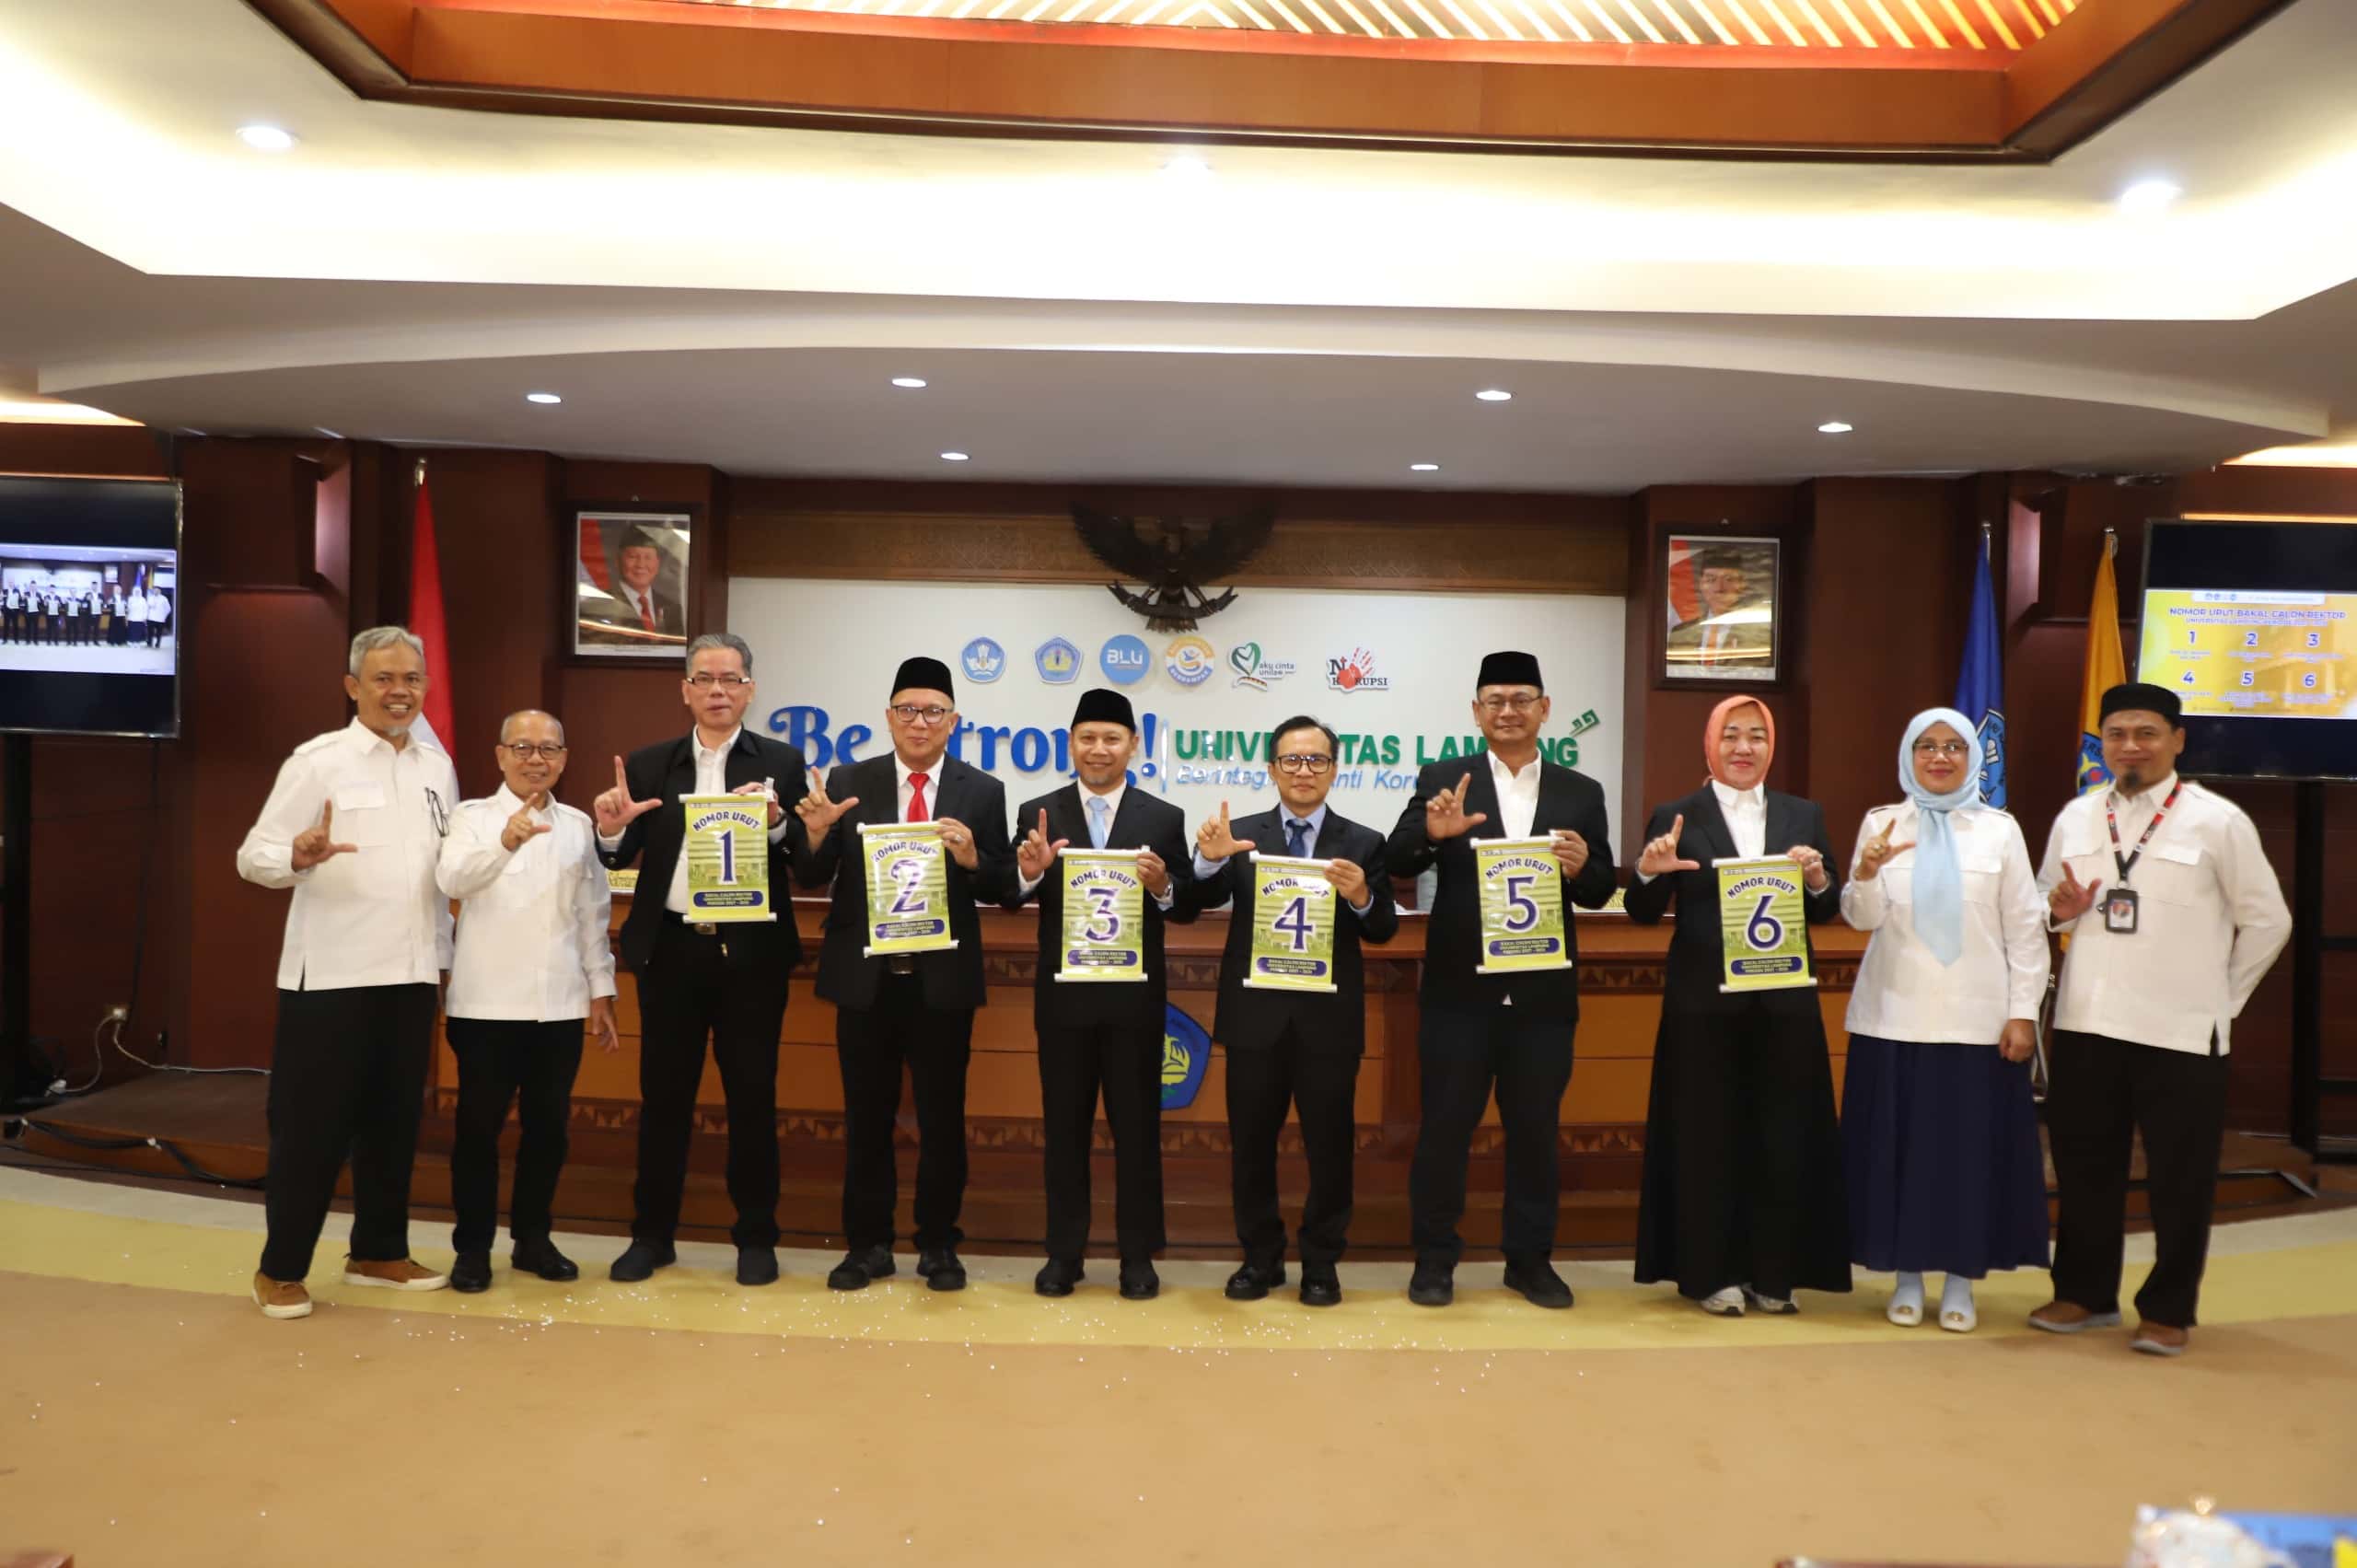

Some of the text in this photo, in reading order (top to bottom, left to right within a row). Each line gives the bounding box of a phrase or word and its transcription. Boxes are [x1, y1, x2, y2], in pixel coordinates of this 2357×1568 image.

[2189, 631, 2196, 644] 1
[2247, 633, 2257, 645] 2
[2308, 633, 2319, 646] 3
[1107, 648, 1144, 664] BLU
[1332, 677, 1388, 686] KRUPSI
[2183, 671, 2195, 684] 4
[2242, 672, 2253, 685] 5
[2305, 674, 2316, 687] 6
[769, 705, 1157, 790] Be tro!
[1175, 729, 1579, 767] UNIVTAS LAMNG
[1176, 765, 1276, 790] Berinteg
[1330, 771, 1363, 789] nti
[692, 811, 761, 831] NOMOR URUT
[720, 830, 734, 882] 1
[1485, 858, 1554, 879] NOMOR URUT
[890, 859, 925, 913] 2
[1109, 870, 1137, 889] URUT
[1727, 877, 1796, 899] NOMOR URUT
[1505, 876, 1537, 930] 5
[1086, 888, 1120, 941] 3
[1274, 897, 1313, 949] 4
[1747, 895, 1782, 949] 6
